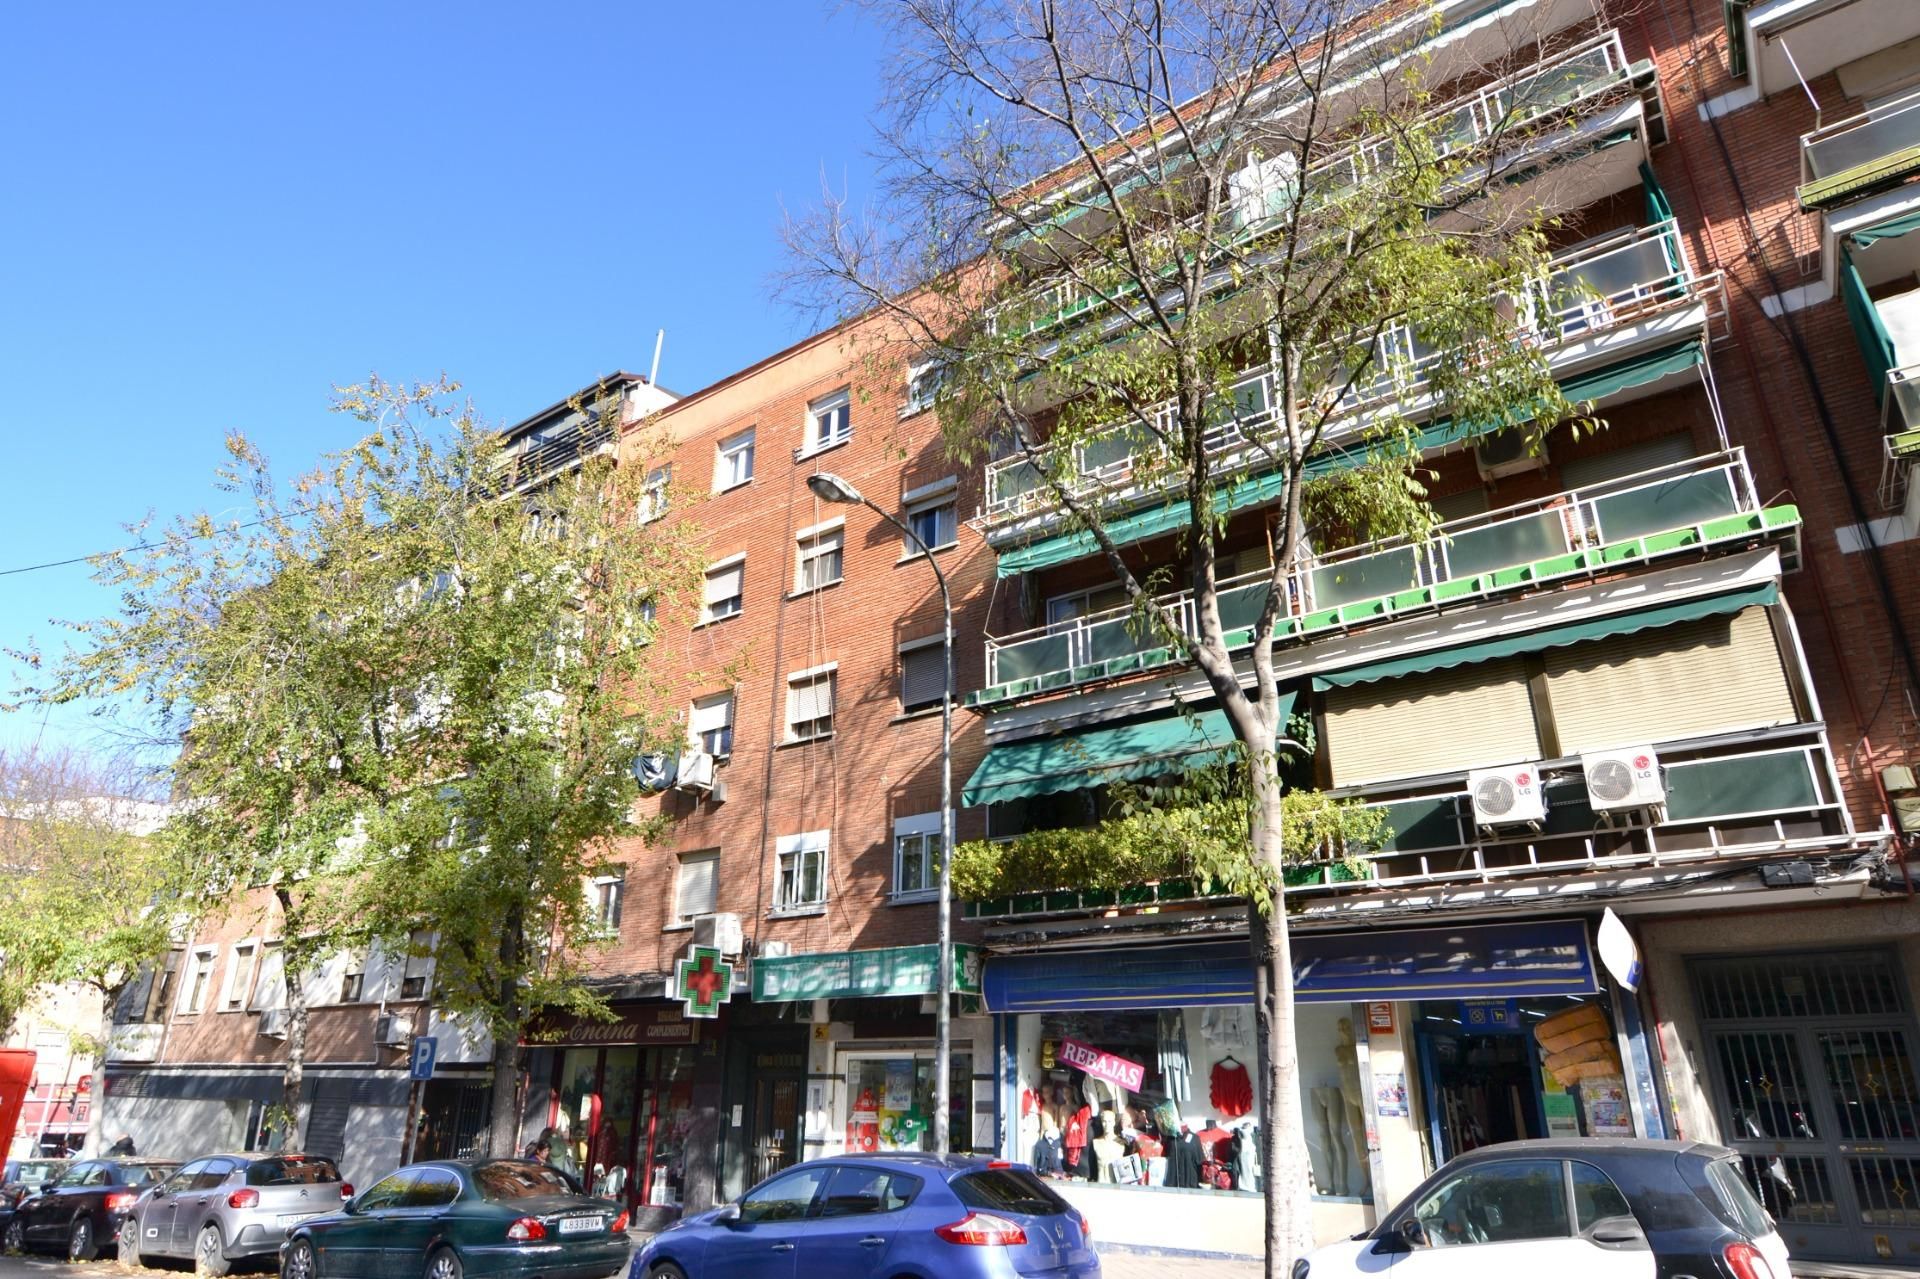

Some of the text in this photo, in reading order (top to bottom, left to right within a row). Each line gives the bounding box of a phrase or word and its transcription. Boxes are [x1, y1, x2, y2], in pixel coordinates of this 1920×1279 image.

[1638, 771, 1651, 779] LG
[1518, 788, 1531, 796] LG
[569, 1017, 639, 1041] Encina
[647, 1024, 690, 1038] COMPLEMENTOS
[414, 1041, 431, 1075] P
[1063, 1042, 1140, 1086] REBAJAS
